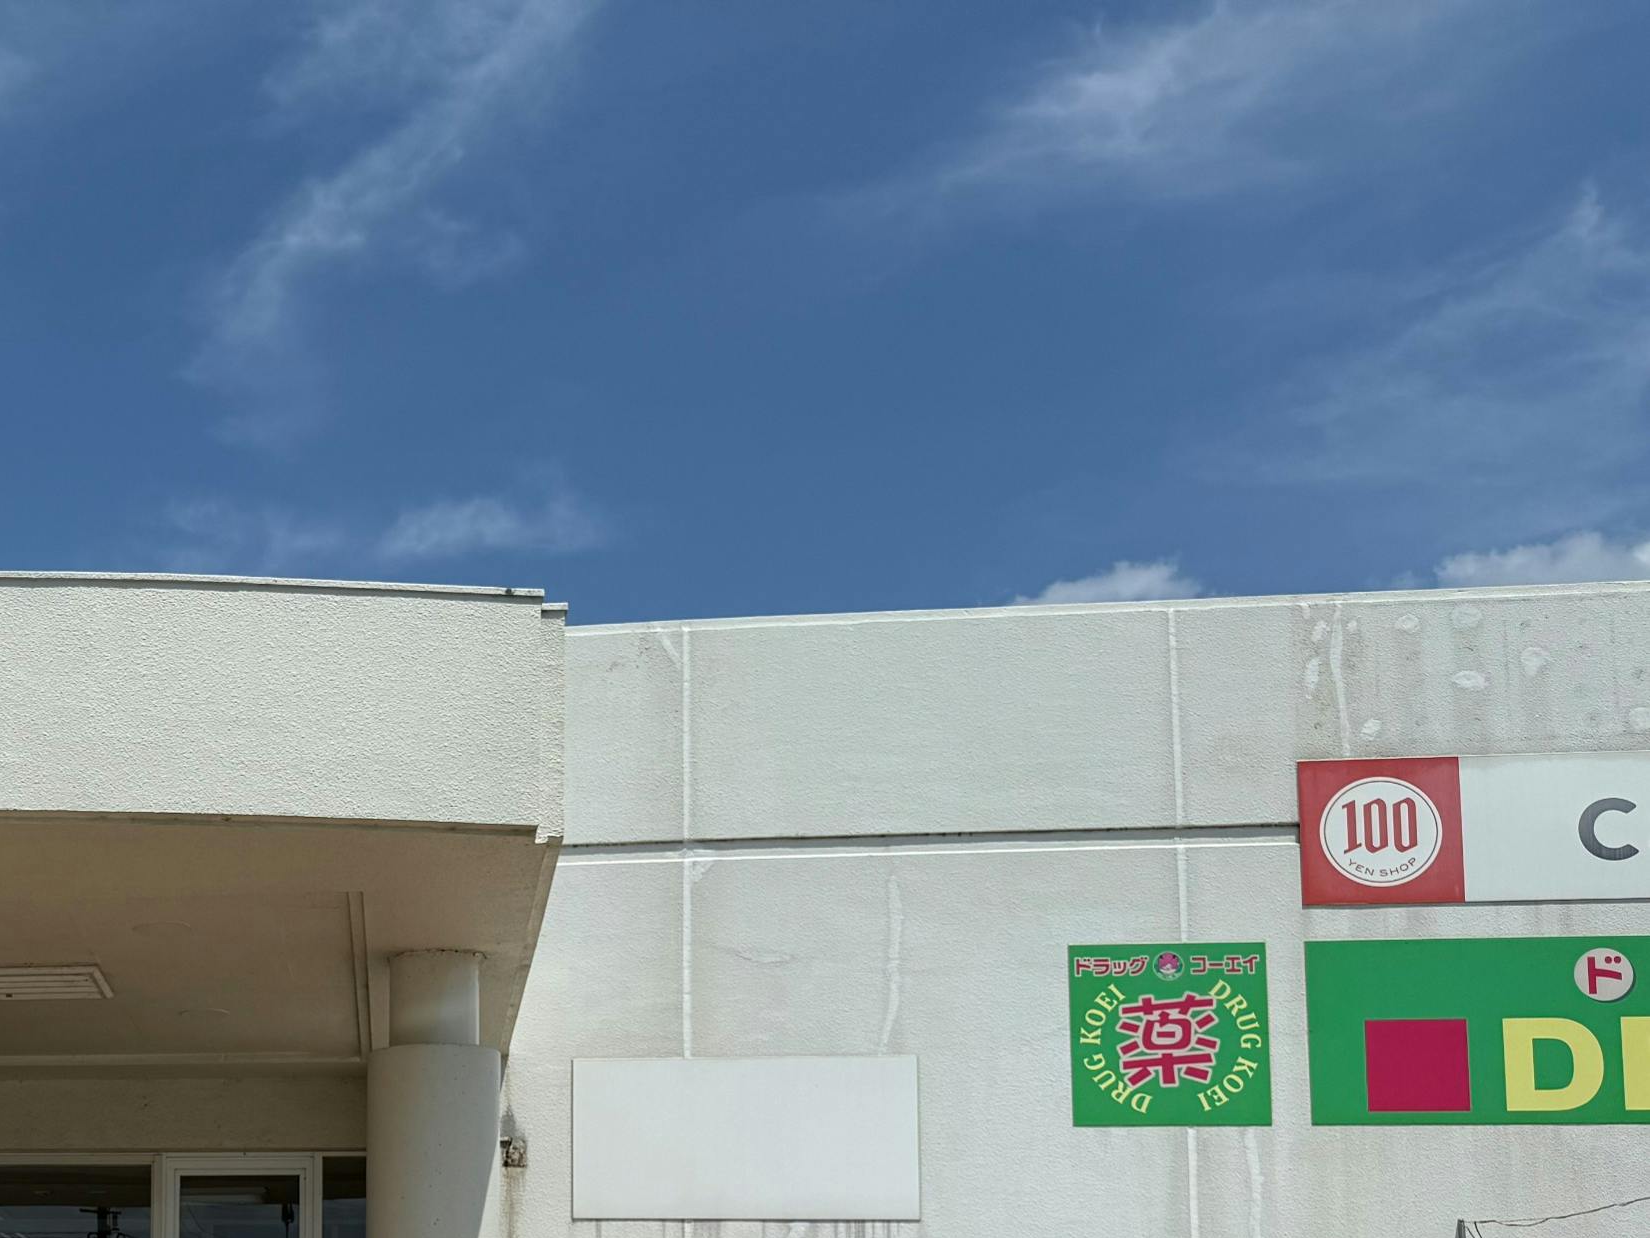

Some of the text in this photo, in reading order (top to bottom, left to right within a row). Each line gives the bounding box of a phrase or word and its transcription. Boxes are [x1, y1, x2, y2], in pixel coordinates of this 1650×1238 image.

[1341, 797, 1418, 855] 100
[1578, 797, 1640, 861] C
[1348, 857, 1417, 877] YEN SHOP
[1074, 955, 1258, 976] ドラッグ コーエイ
[1080, 983, 1153, 1114] DRUG KOEI
[1117, 992, 1220, 1087] 薬
[1197, 979, 1262, 1112] DRUG KOEI
[1502, 1016, 1650, 1112] D
